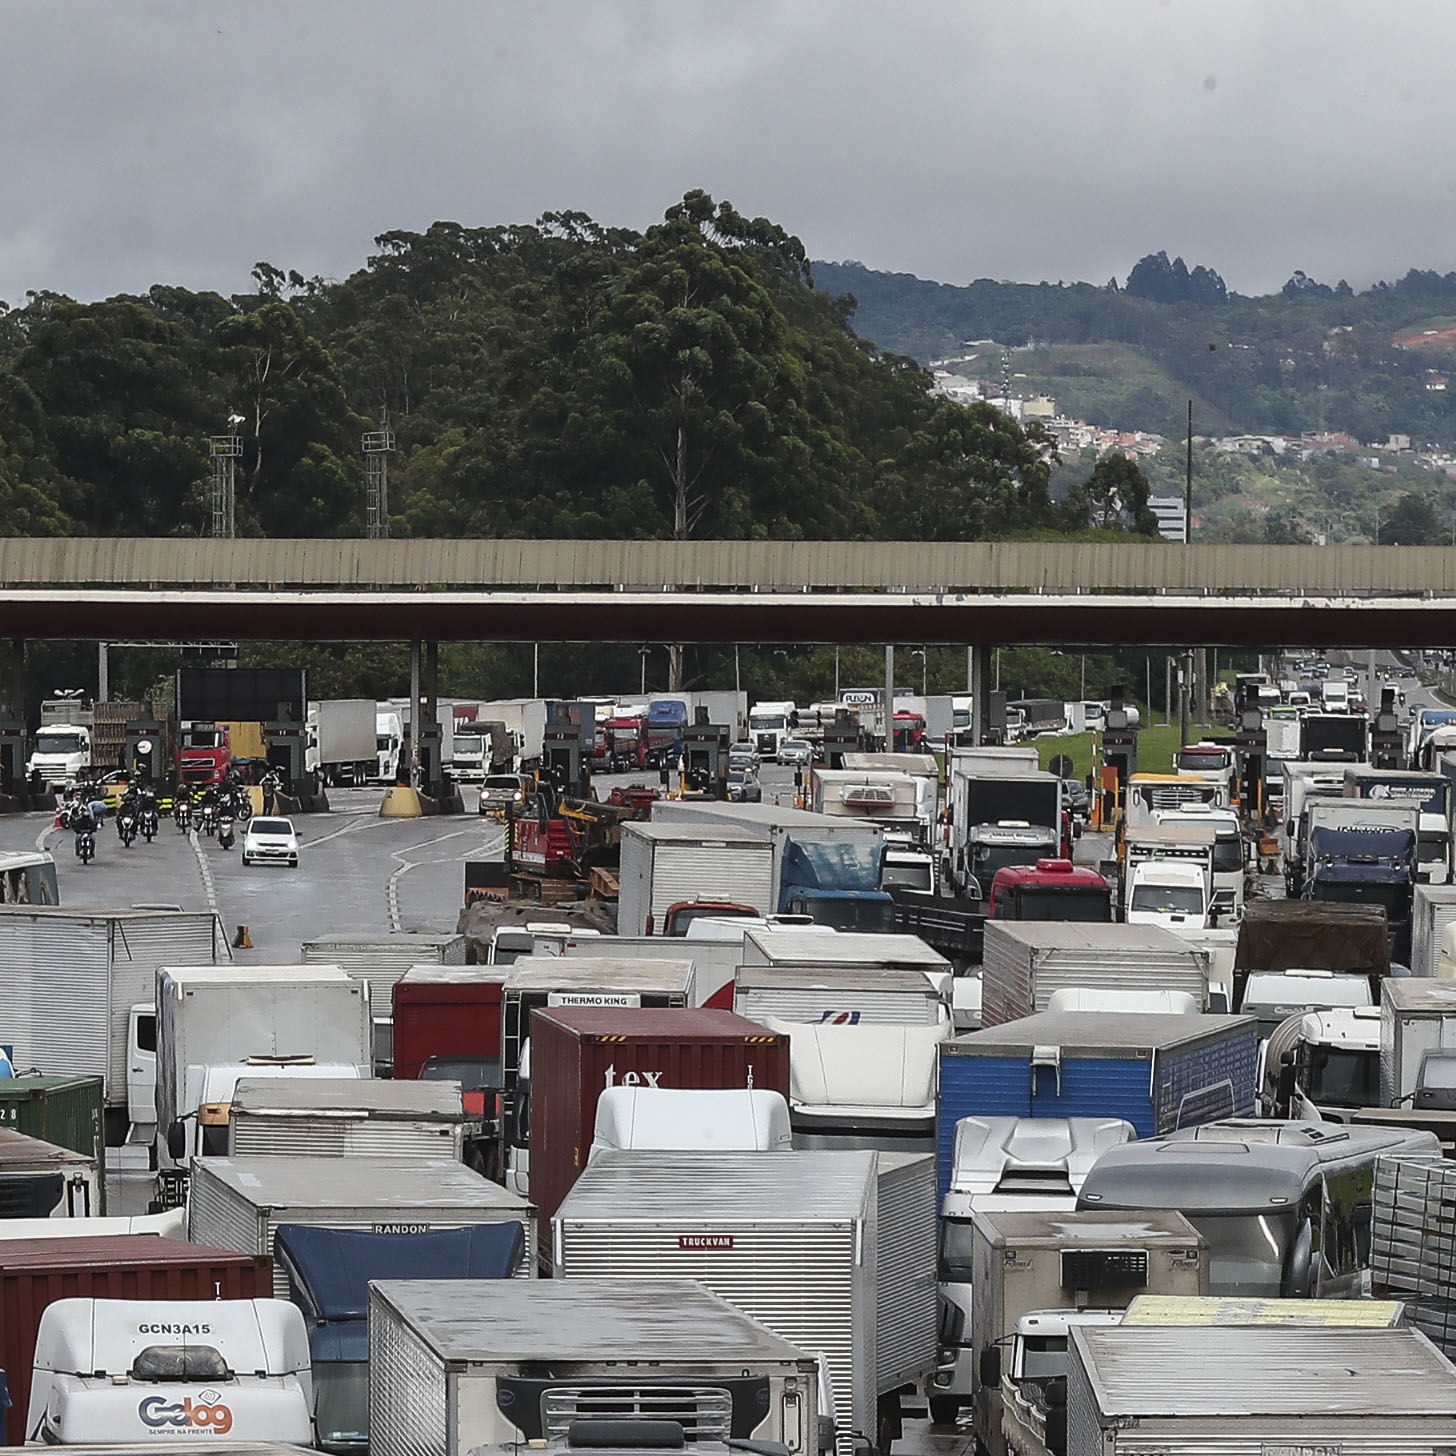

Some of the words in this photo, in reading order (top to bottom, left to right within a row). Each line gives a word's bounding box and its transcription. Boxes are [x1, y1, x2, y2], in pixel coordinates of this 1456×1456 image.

[561, 996, 602, 1005] THERMO
[604, 997, 628, 1005] KING
[375, 1225, 427, 1234] RANDON
[682, 1237, 731, 1246] TRUCKVAN
[138, 1323, 211, 1334] GCN3A15
